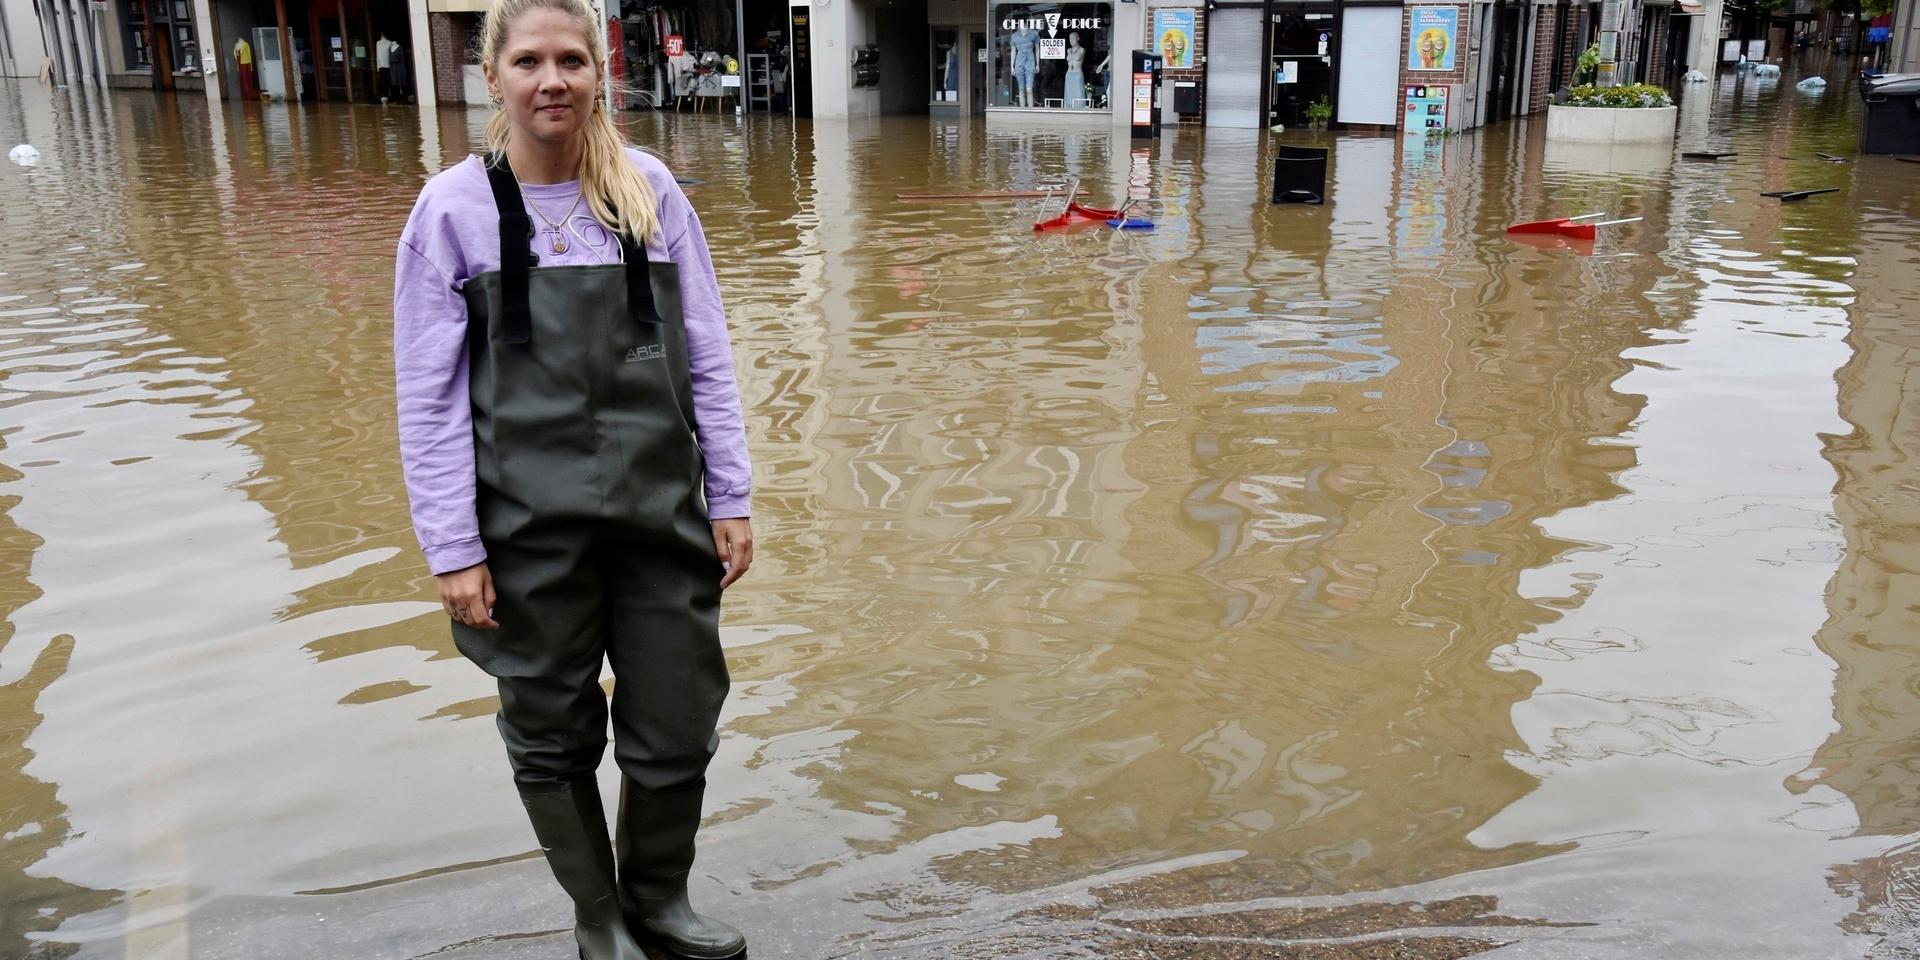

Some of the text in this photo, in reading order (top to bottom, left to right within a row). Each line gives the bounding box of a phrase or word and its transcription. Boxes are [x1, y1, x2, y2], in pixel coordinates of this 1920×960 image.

[1003, 18, 1045, 29] CHUTE
[1063, 18, 1101, 29] PRICE
[1042, 39, 1064, 47] SOLDES
[1144, 59, 1152, 71] P
